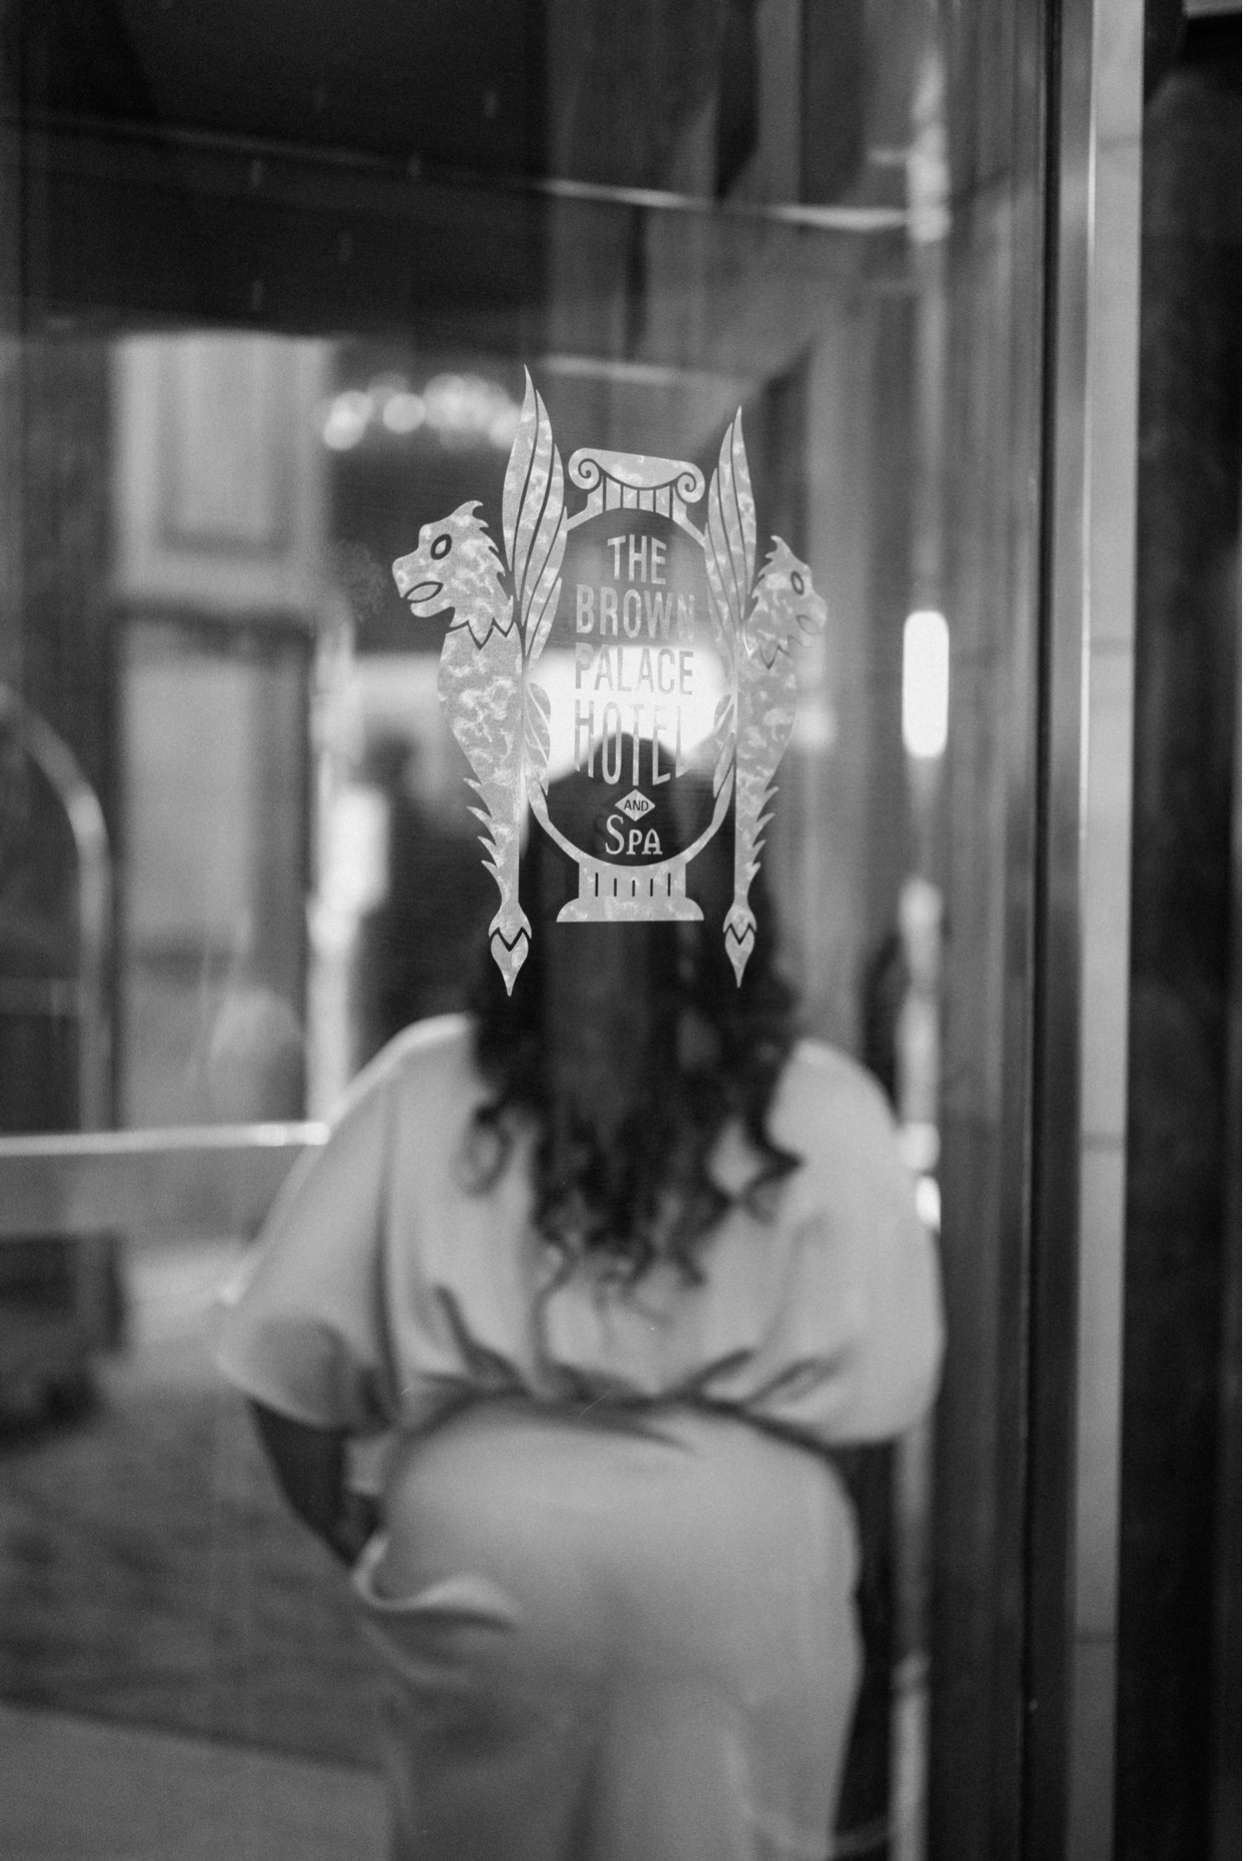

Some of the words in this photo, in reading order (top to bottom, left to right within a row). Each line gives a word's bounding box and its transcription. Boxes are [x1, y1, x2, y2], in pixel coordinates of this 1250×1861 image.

[607, 534, 667, 585] THE
[576, 584, 695, 639] BROWN
[575, 642, 694, 695] PALACE
[574, 699, 692, 787] HOTEL
[623, 799, 650, 812] AND
[605, 814, 663, 856] SPA
